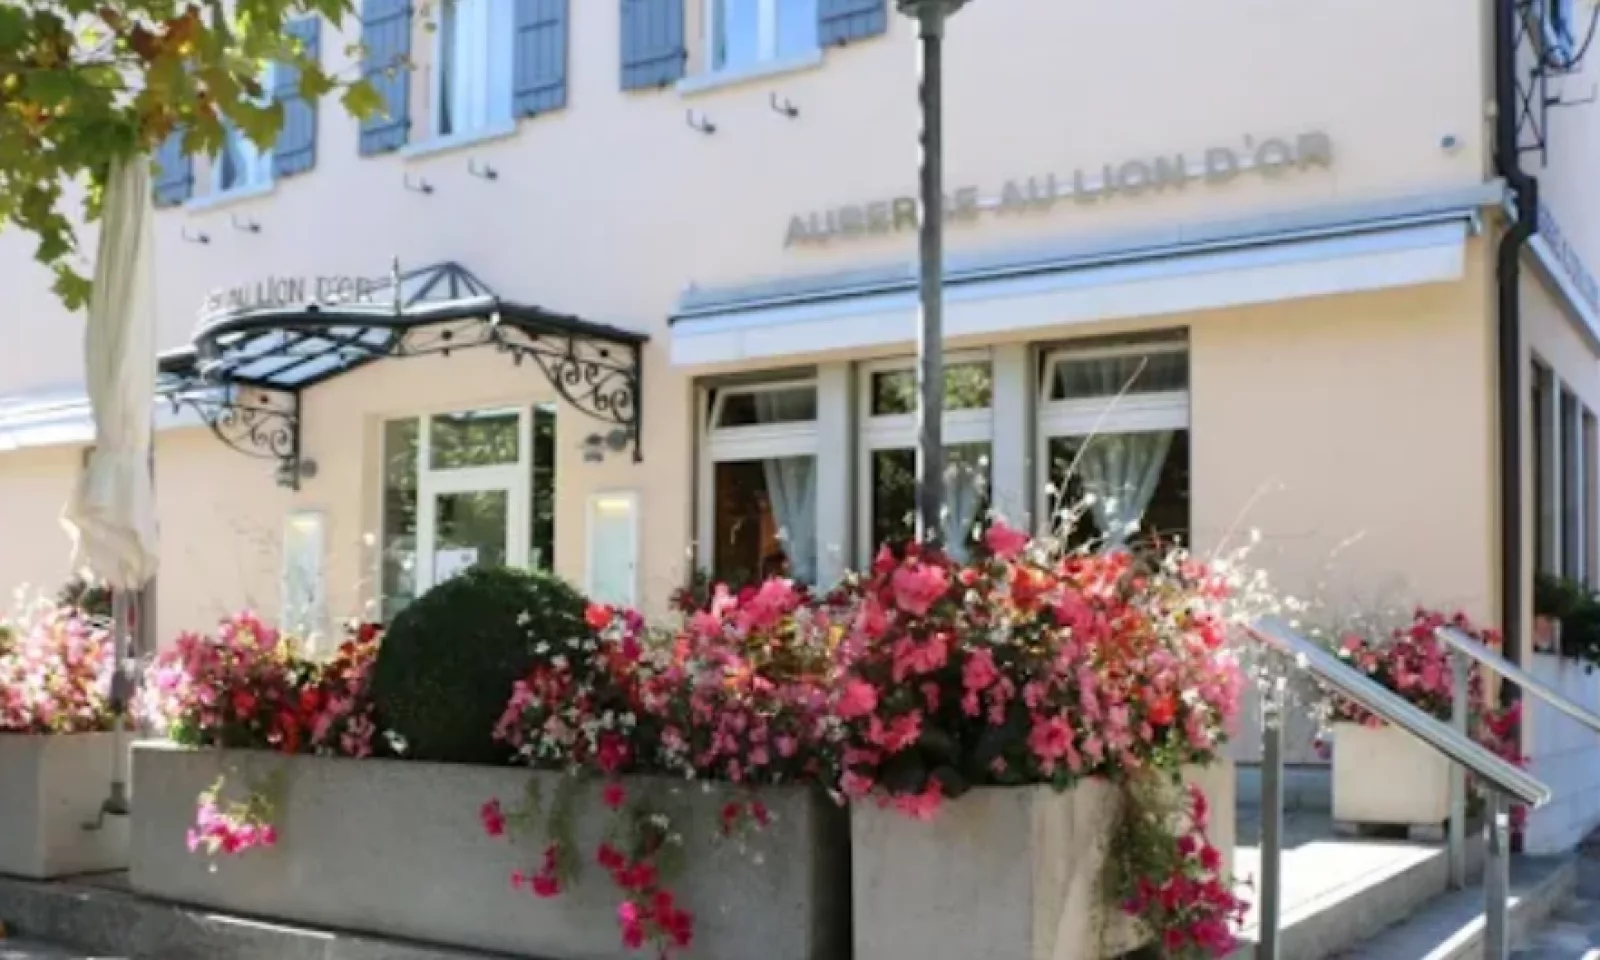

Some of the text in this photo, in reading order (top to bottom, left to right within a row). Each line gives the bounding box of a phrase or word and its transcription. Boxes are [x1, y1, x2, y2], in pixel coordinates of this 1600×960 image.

[996, 171, 1057, 215] AU
[1072, 152, 1187, 204] LION
[1204, 130, 1332, 184] D'OR
